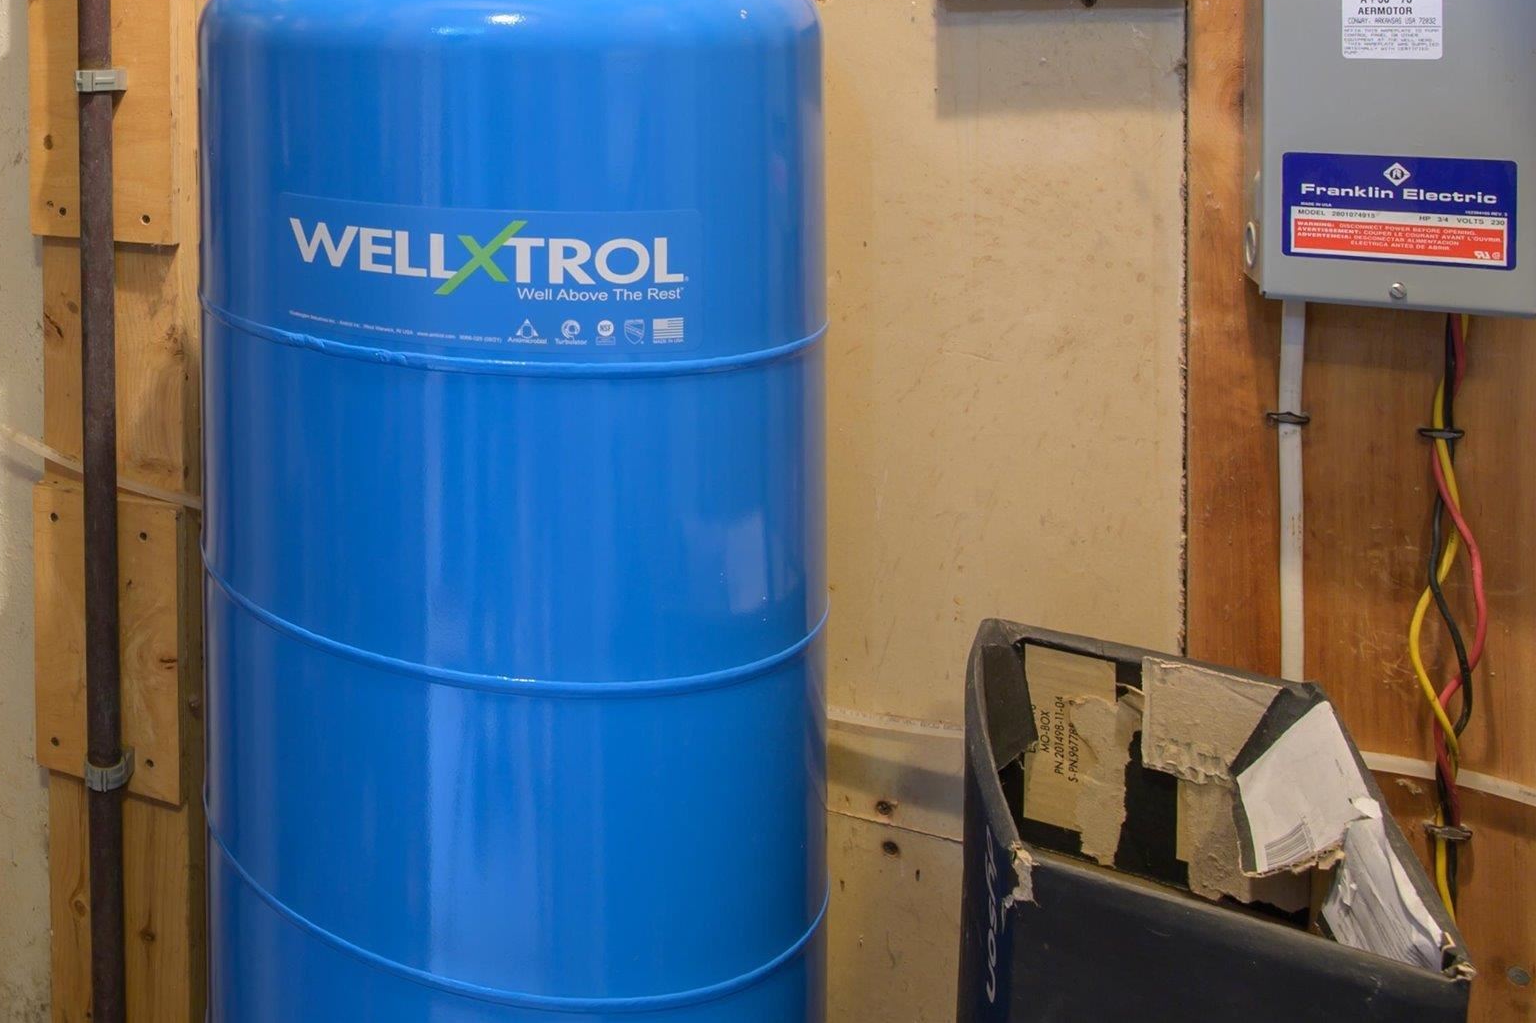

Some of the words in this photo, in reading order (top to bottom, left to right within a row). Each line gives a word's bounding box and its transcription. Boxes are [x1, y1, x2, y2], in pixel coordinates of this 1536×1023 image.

[1300, 183, 1394, 198] Franklin
[1403, 188, 1497, 204] Electric
[518, 288, 552, 300] Well
[557, 289, 608, 301] Above
[613, 288, 642, 300] The
[1040, 710, 1050, 753] MO-BOX
[985, 825, 997, 1003] dyson
